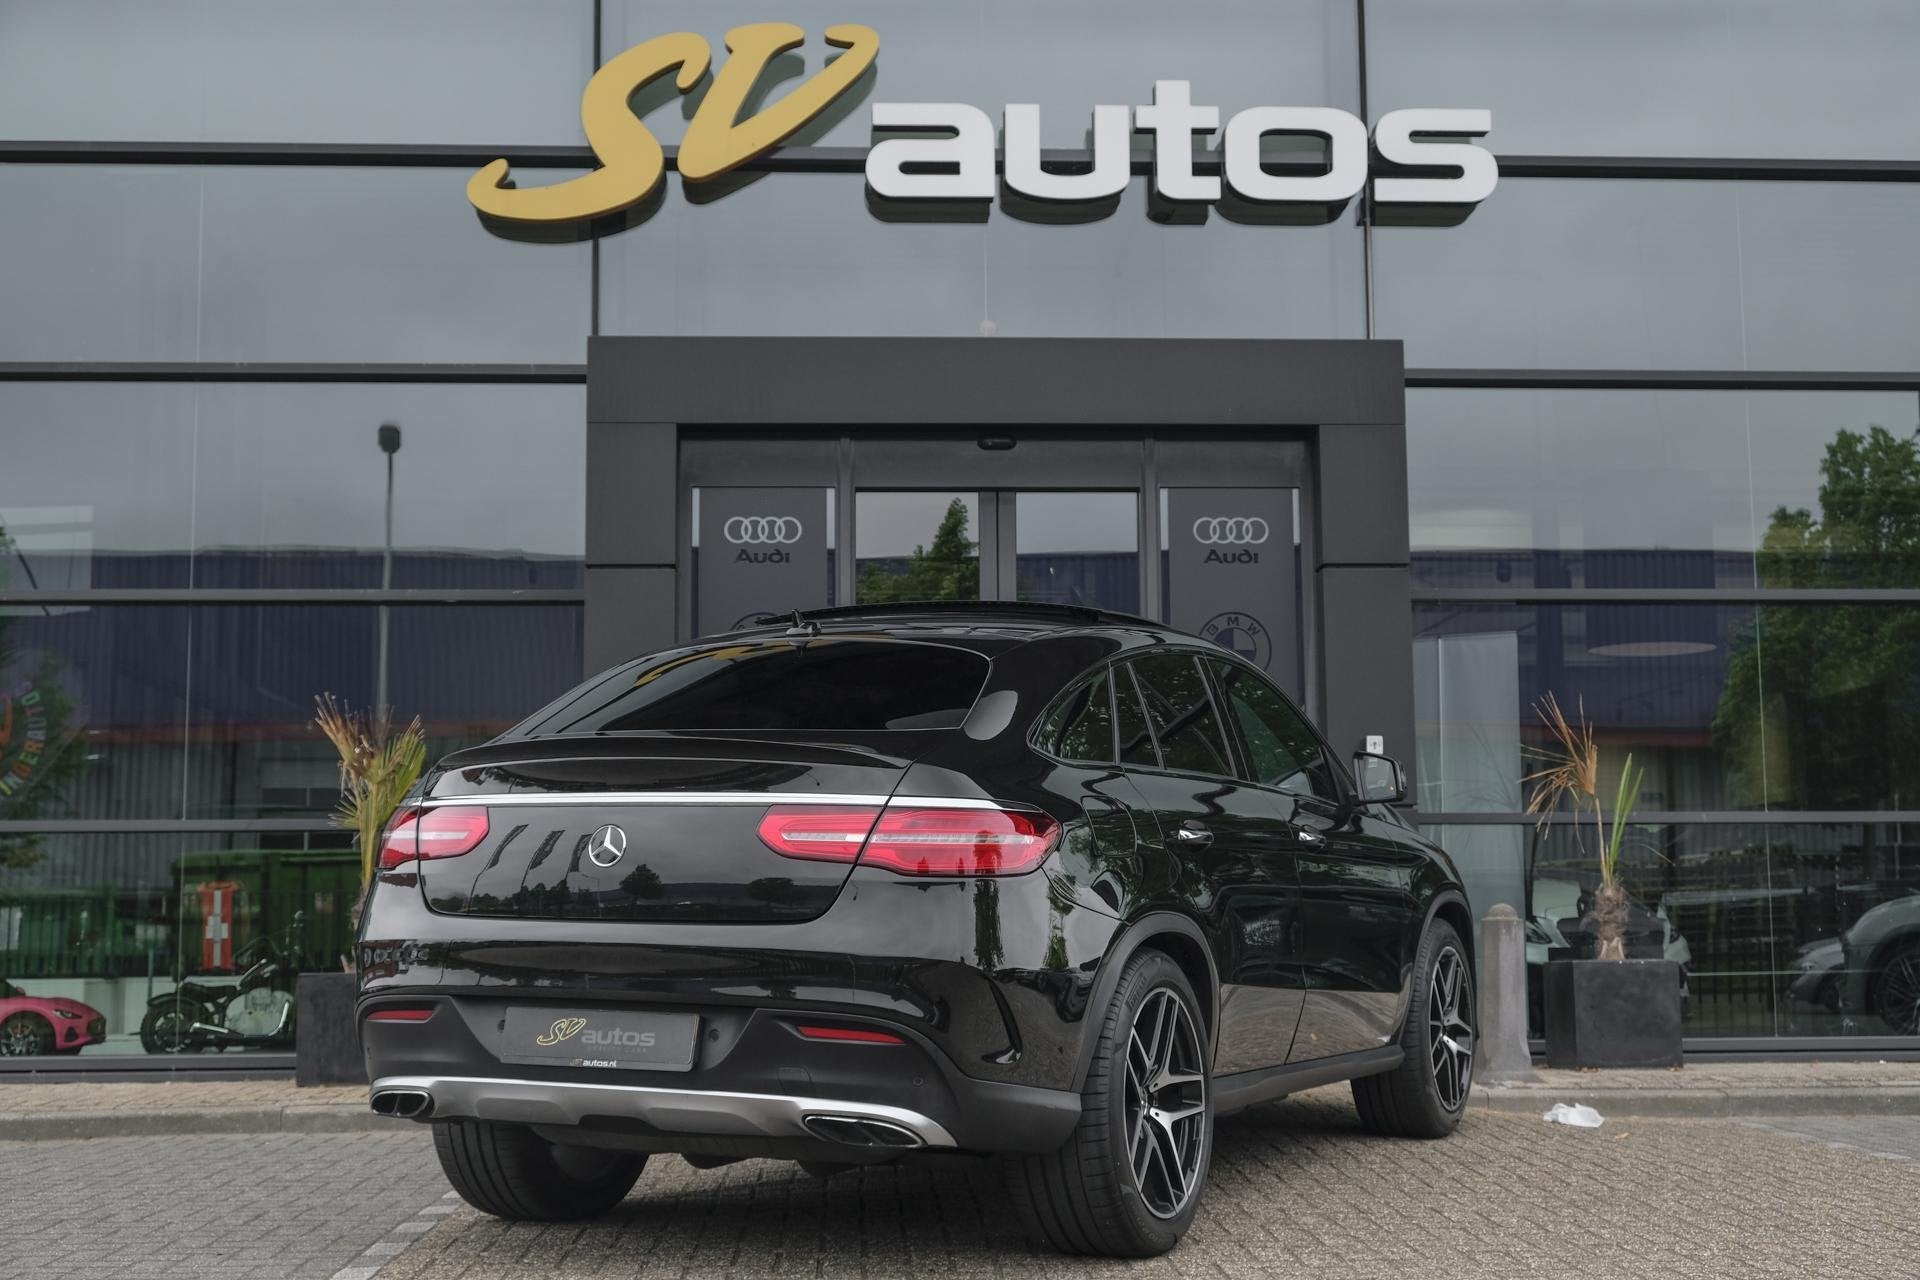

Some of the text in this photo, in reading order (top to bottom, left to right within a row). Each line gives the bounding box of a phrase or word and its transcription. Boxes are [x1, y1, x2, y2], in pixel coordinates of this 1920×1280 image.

[467, 22, 1499, 221] SV autos
[734, 548, 791, 564] Audi
[1203, 548, 1260, 564] Audi
[1207, 615, 1261, 637] BMW
[536, 1017, 656, 1048] SV autos
